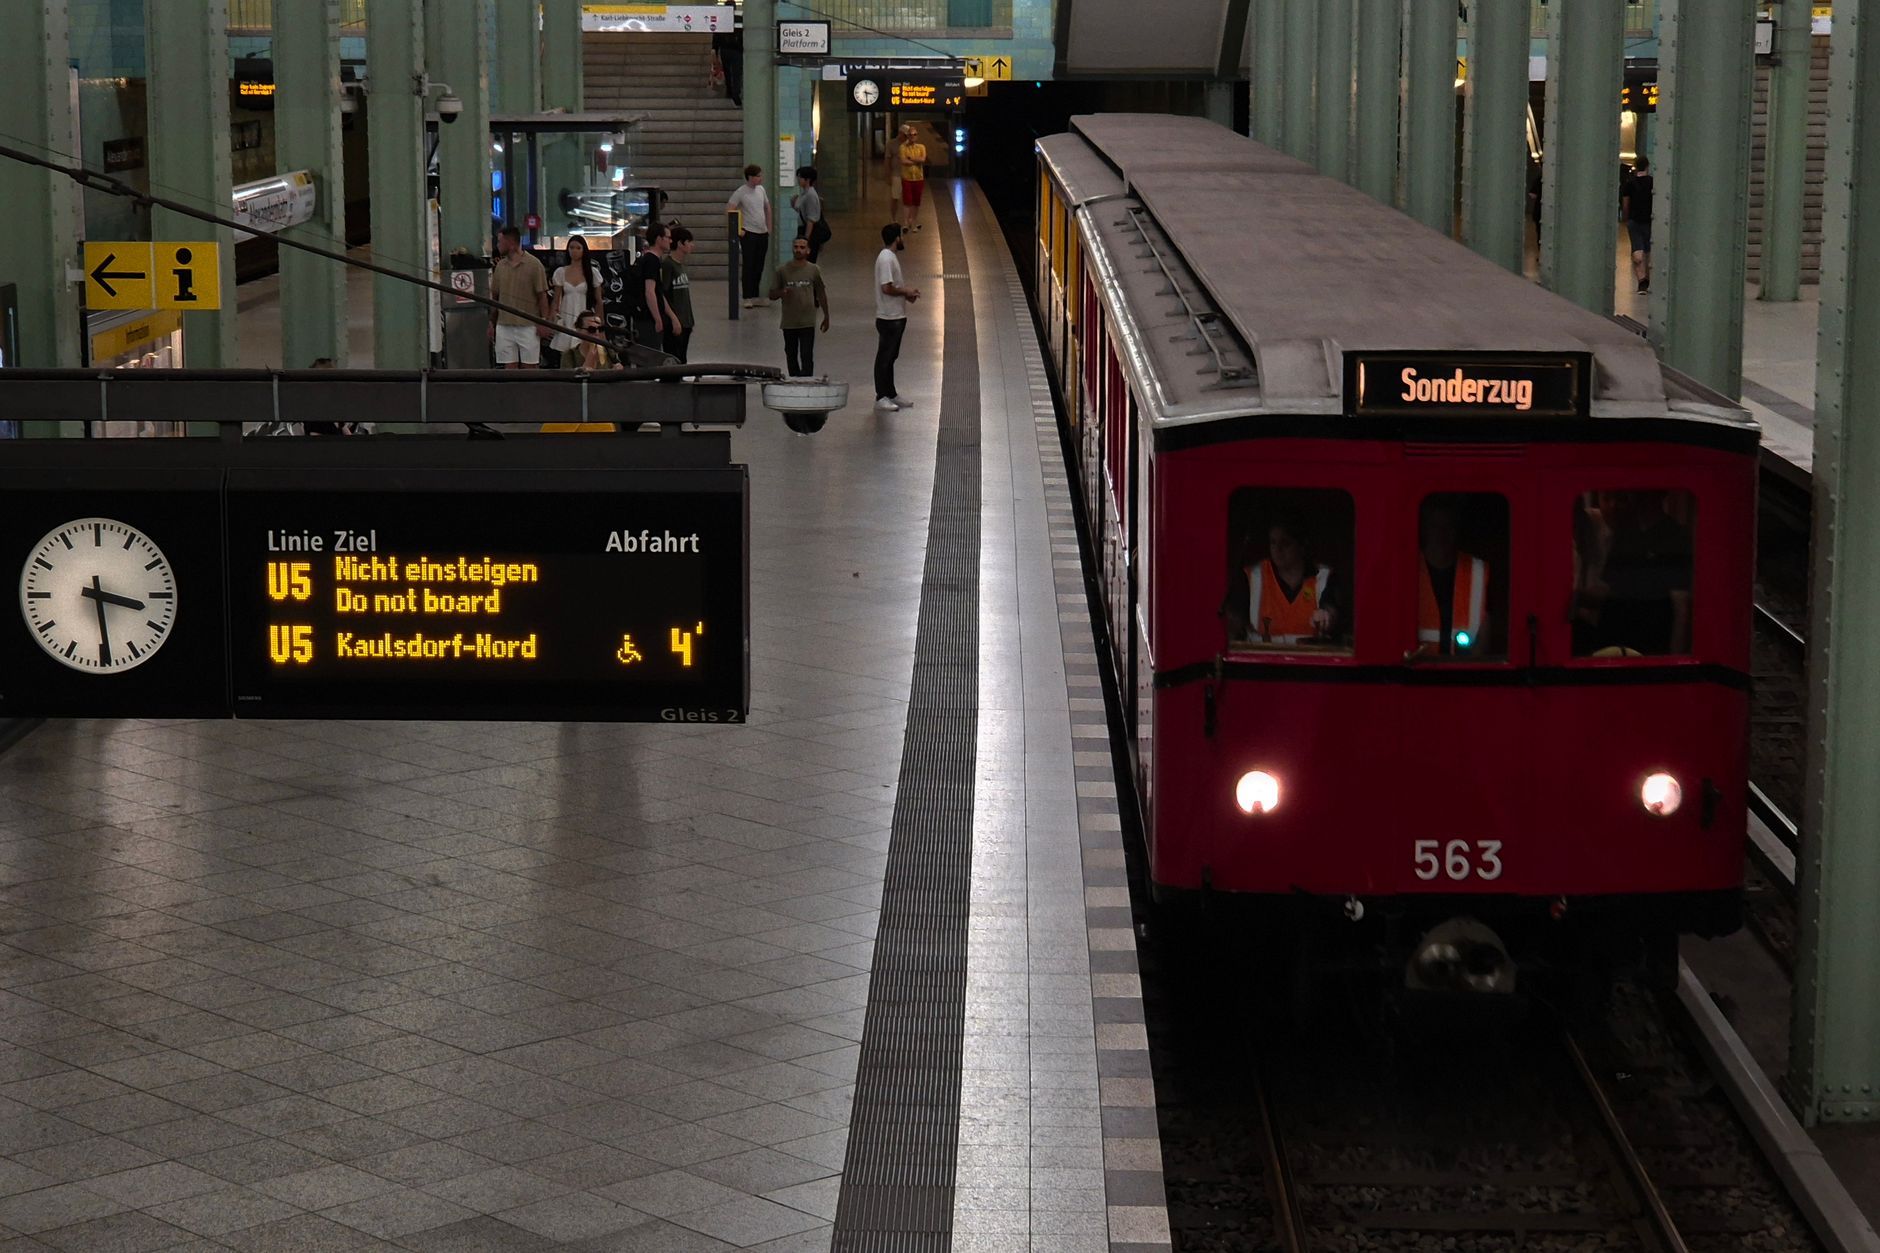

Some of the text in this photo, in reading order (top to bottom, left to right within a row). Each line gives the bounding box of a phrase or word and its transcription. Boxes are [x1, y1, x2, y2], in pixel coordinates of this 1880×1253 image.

[782, 28, 810, 37] Gleis 2
[782, 39, 826, 48] Platform 2
[1400, 367, 1533, 411] Sonderzug
[267, 529, 699, 553] Linie Ziel Abfahrt
[267, 562, 312, 600] U5
[335, 556, 538, 587] Nicht einsteigen
[336, 586, 500, 613] Do not board
[269, 624, 313, 663] U5
[337, 632, 537, 659] Kaulsdorf-Nord
[660, 707, 739, 722] Gleis 2
[1414, 839, 1503, 881] 563
